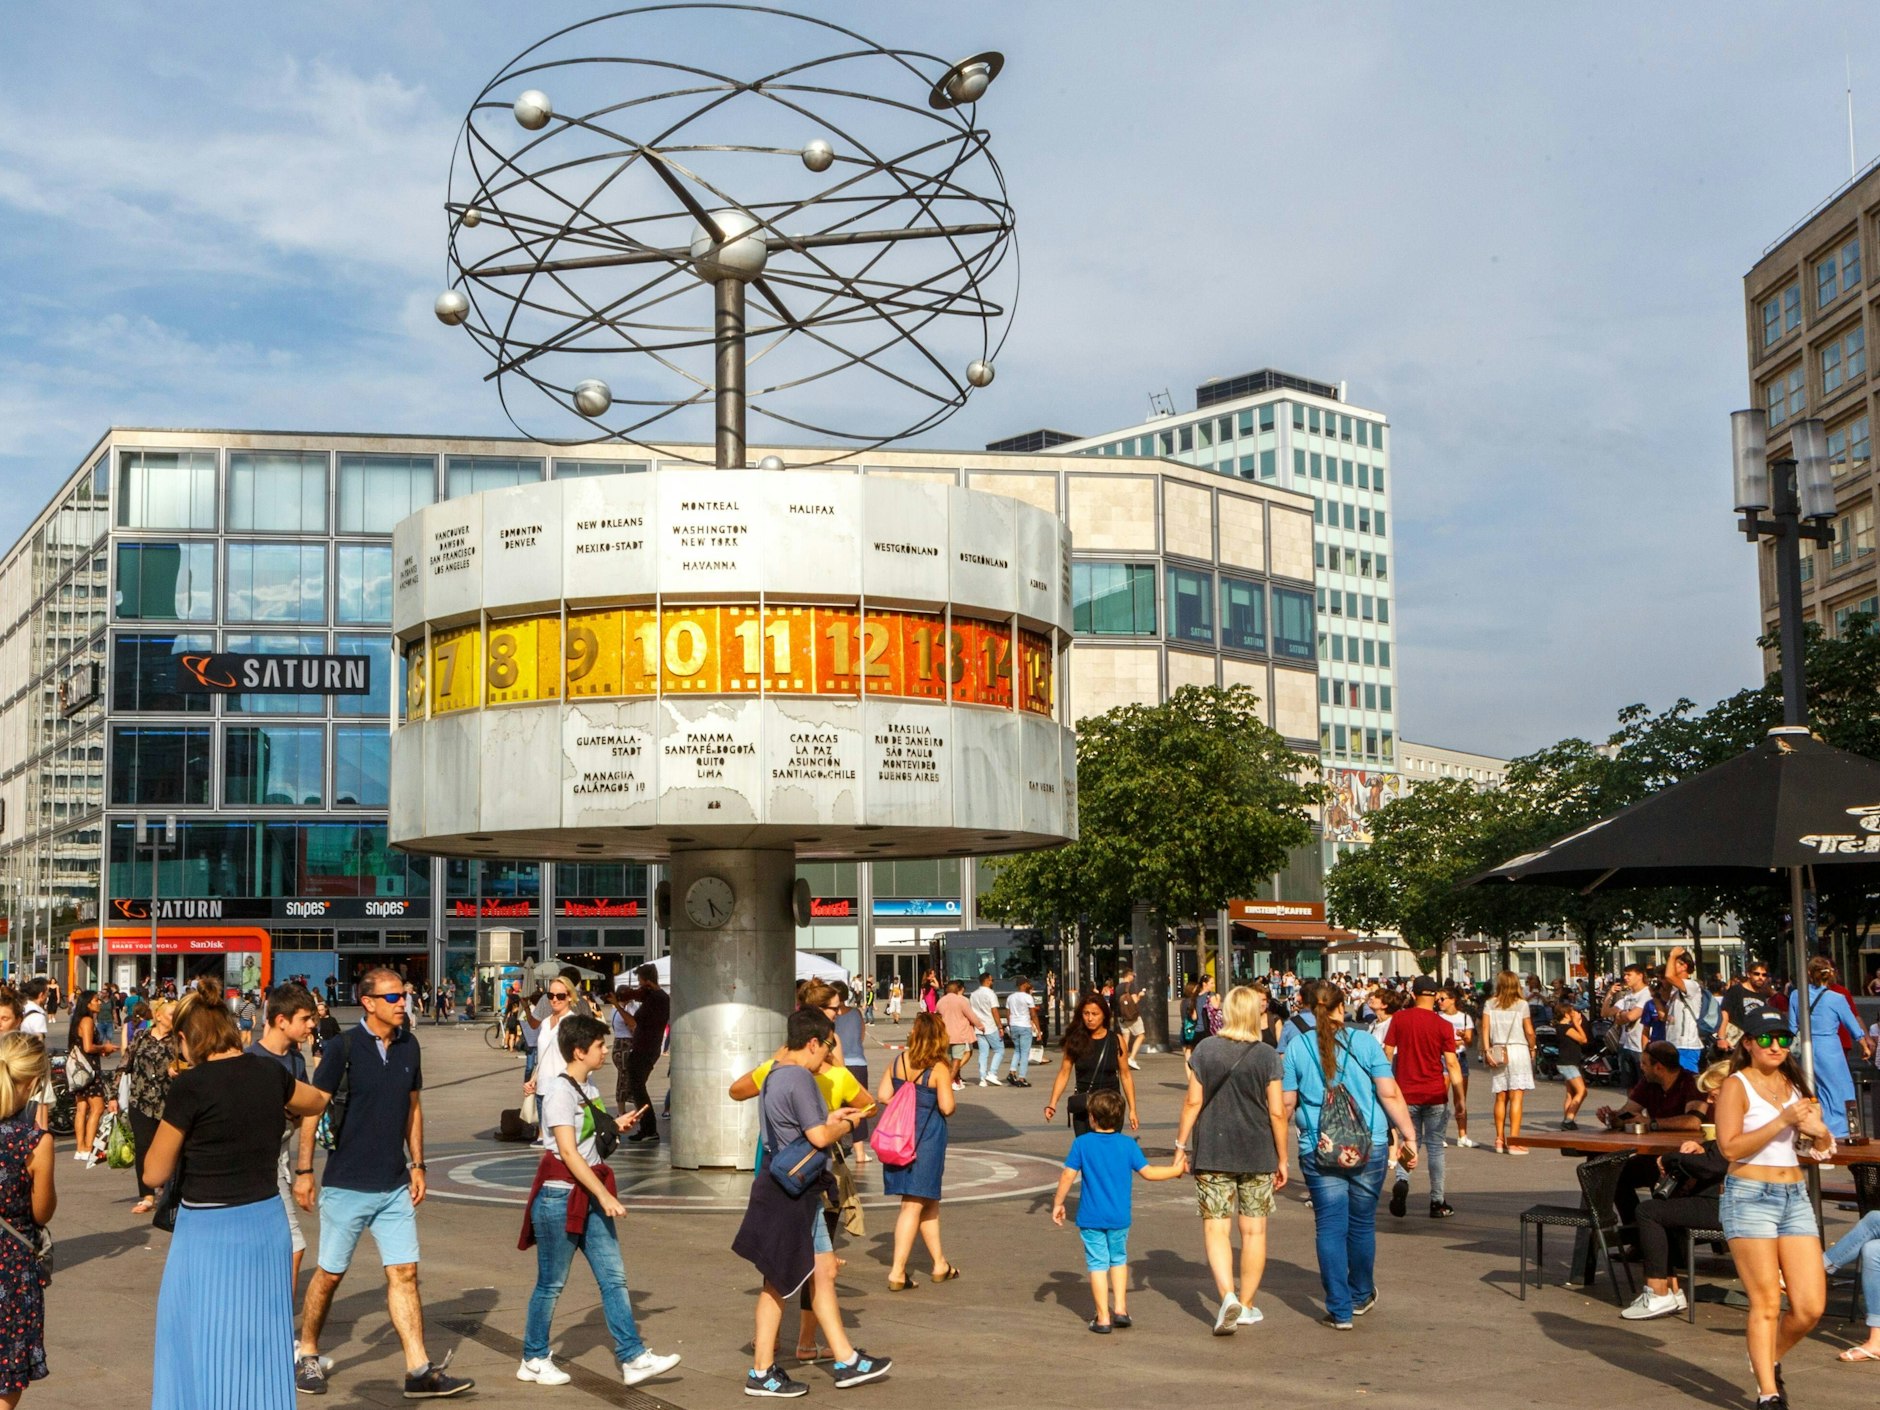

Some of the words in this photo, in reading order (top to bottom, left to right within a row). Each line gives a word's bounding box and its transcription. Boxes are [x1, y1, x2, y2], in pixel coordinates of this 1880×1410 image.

[682, 501, 740, 511] MONTREAL
[789, 504, 835, 515] HALIFAX
[577, 520, 597, 530] NEW
[601, 517, 644, 529] ORLEANS
[672, 525, 748, 534] WASHINGTON
[435, 525, 470, 541] VANCOUVER
[500, 525, 543, 538] EDMONTON
[440, 538, 465, 551] DAWSON
[505, 538, 536, 550] DENVER
[576, 541, 644, 554] MEXIKO-STADT
[681, 538, 706, 546] NEW
[711, 538, 738, 546] YORK
[873, 542, 939, 556] WESTGRÖNLAND
[430, 554, 441, 566] SAN
[442, 546, 476, 562] FRANCISCO
[960, 552, 1008, 569] OSTGRÖNLAND
[434, 565, 444, 576] LOS
[445, 560, 470, 574] ANGELES
[682, 561, 737, 571] HAVANNA
[632, 620, 708, 677] 10
[734, 620, 792, 674] 11
[826, 621, 890, 677] 12
[565, 627, 599, 682] 9
[912, 627, 965, 684] 13
[488, 634, 519, 688] 8
[242, 658, 366, 690] SATURN
[437, 642, 460, 697] 7
[888, 724, 931, 735] BRASILIA
[576, 735, 642, 746] GUATEMALA-
[687, 733, 734, 742] PANAMA
[790, 734, 838, 744] CARACAS
[874, 736, 889, 744] RIO
[892, 736, 902, 745] DE
[905, 736, 944, 747] JANEIRO
[612, 746, 642, 756] STADT
[717, 743, 756, 754] BOGOTÁ
[795, 746, 809, 755] LA
[814, 746, 832, 755] PAZ
[886, 746, 902, 757] SÃO
[906, 748, 933, 758] PAULO
[696, 757, 725, 766] QUITO
[788, 756, 841, 767] ASUNCIÓN
[882, 760, 936, 770] MONTEVIDEO
[584, 771, 634, 782] MANAGUA
[697, 769, 723, 778] LIMA
[772, 769, 823, 779] SANTIAGO
[828, 770, 856, 780] CHILE
[879, 772, 912, 781] BUENOS
[914, 772, 940, 782] AIRES
[573, 782, 630, 794] GALÁPAGOS
[150, 900, 222, 918] SATURN
[286, 901, 326, 918] snipes
[365, 901, 405, 918] snipes
[1284, 906, 1313, 916] KAFFEE
[190, 940, 224, 949] SanDisk
